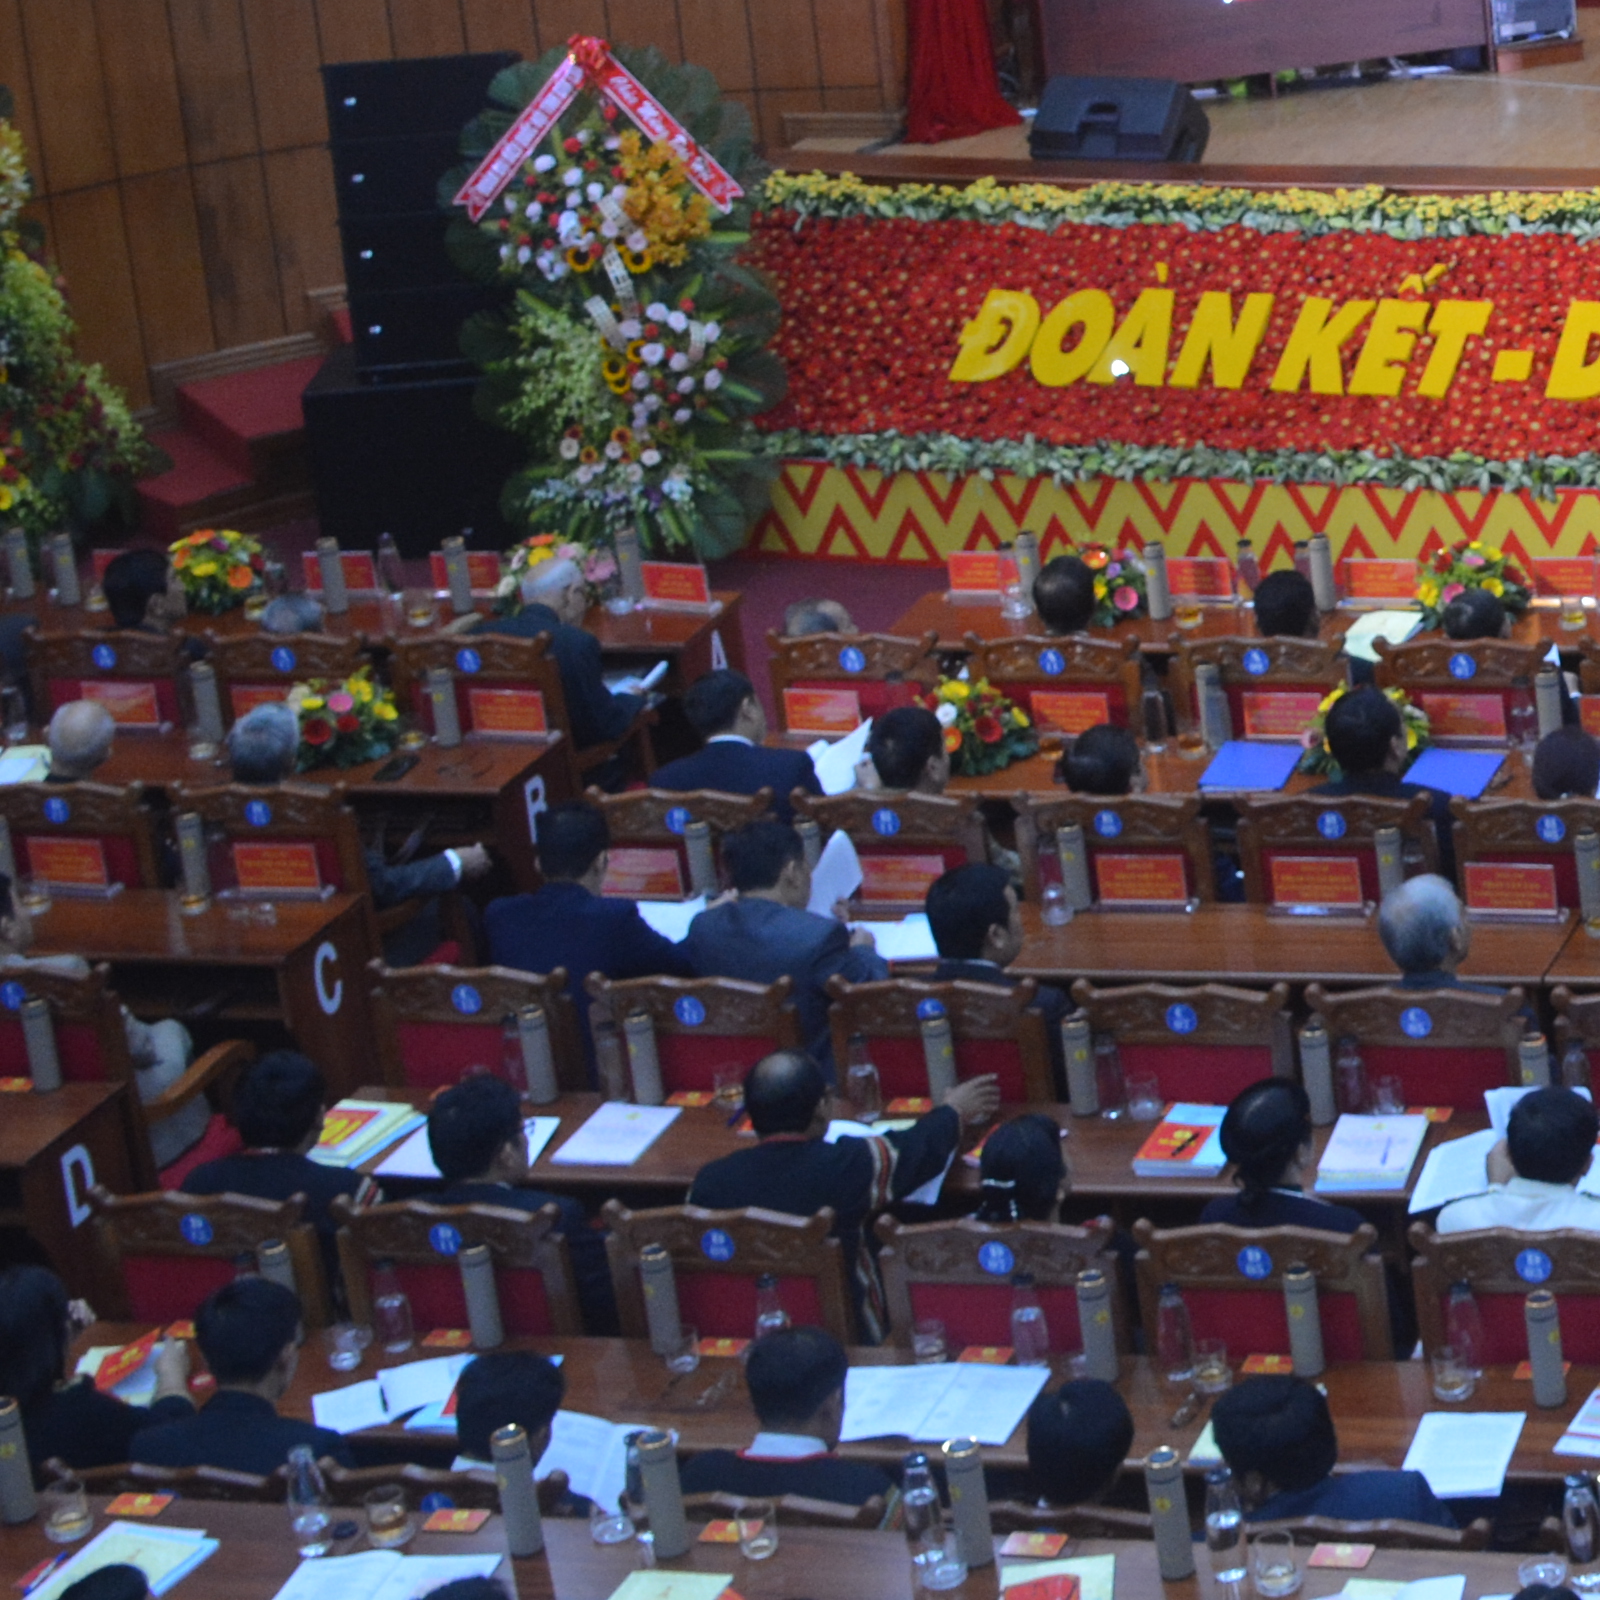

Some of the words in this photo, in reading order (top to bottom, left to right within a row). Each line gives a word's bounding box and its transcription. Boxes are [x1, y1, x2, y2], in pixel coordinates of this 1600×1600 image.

[949, 264, 1275, 388] ĐOÀN
[1269, 262, 1493, 398] KẾT
[314, 942, 342, 1014] C
